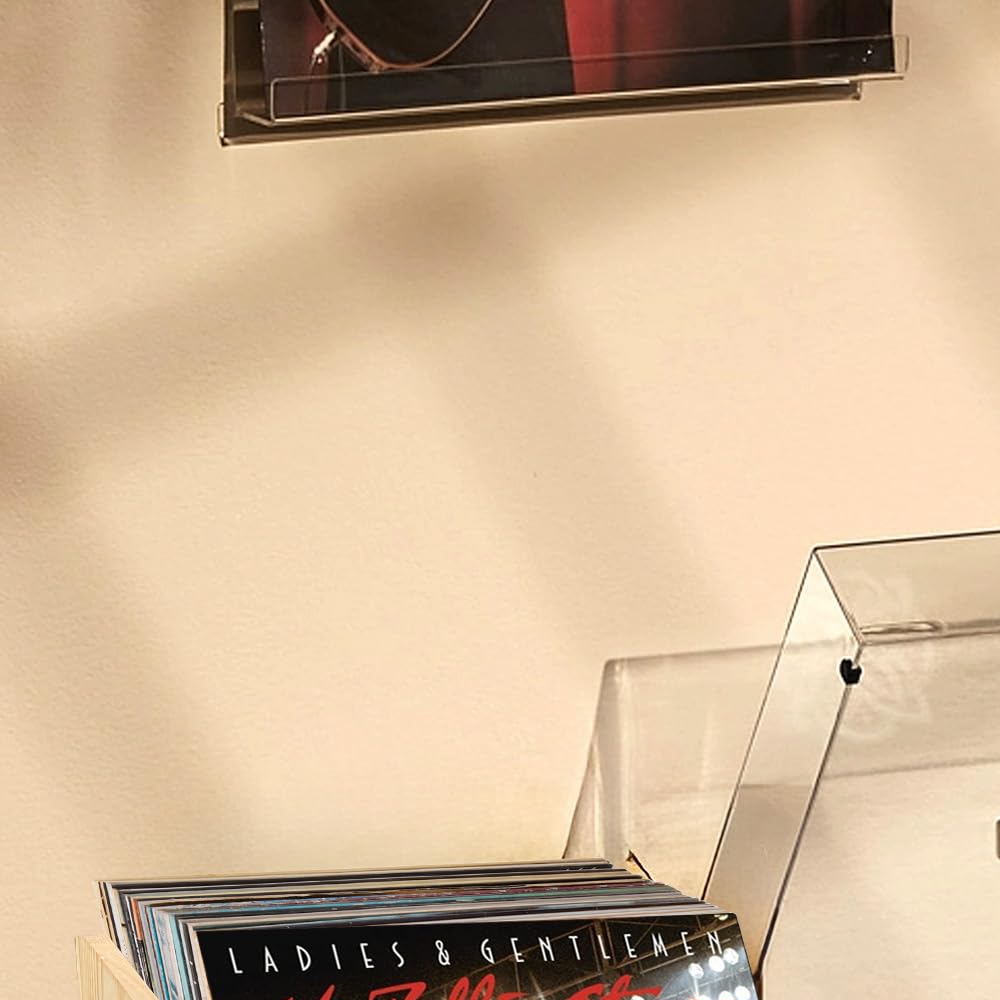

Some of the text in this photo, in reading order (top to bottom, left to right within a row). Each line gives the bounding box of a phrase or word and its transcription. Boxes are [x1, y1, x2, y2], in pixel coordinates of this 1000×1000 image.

[229, 930, 724, 975] LADIES & GENTLEMEN
